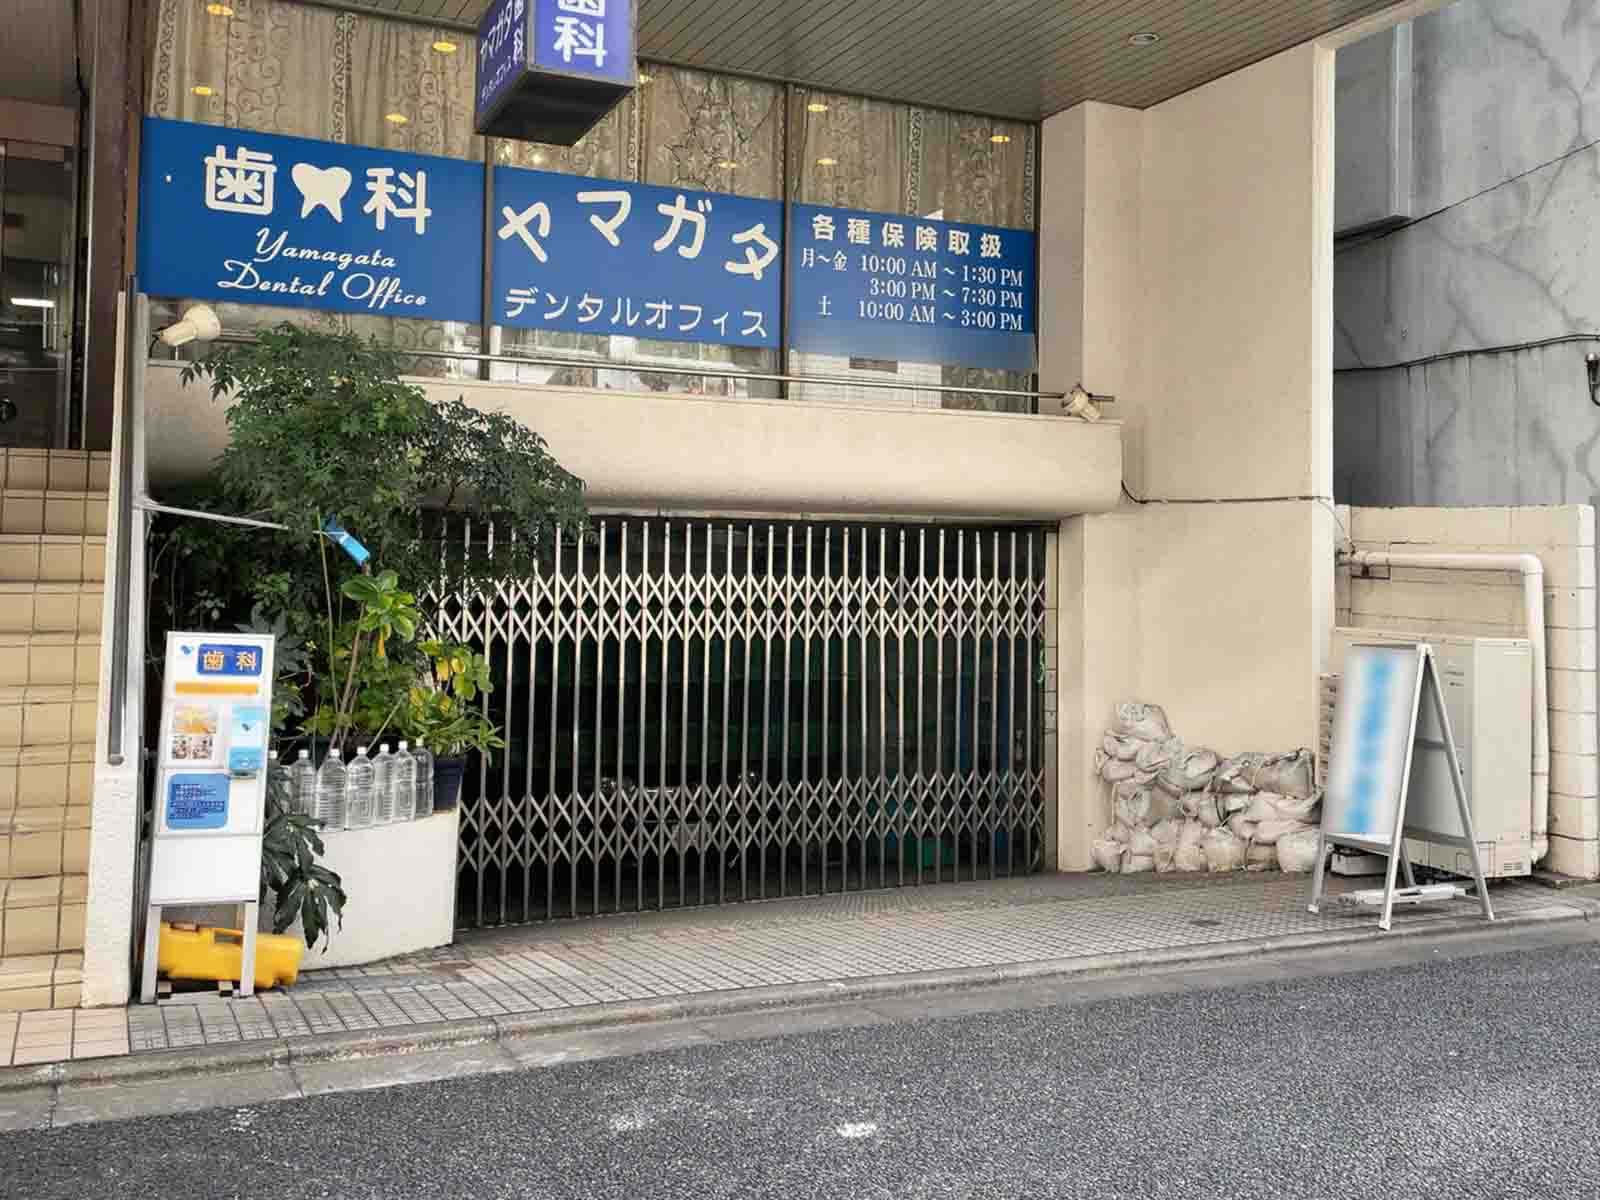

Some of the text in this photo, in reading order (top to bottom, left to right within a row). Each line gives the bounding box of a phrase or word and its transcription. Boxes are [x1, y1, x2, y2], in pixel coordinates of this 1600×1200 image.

[253, 228, 397, 271] Yamagata
[498, 190, 780, 281] ヤマガタ
[811, 213, 1003, 259] 各種保険取扱
[216, 260, 428, 309] Dental Office
[861, 255, 907, 276] 10:00
[911, 261, 938, 279] AM
[962, 265, 997, 284] 1:30
[1000, 269, 1024, 287] PM
[505, 287, 768, 338] デンタルオフィス
[858, 300, 905, 321] 10:00
[908, 305, 936, 324] AM
[961, 310, 997, 329] 3:00
[1000, 313, 1023, 331] PM
[869, 278, 907, 298] 3:00
[911, 282, 936, 301] PM
[961, 287, 997, 307] 7:30
[1000, 290, 1023, 309] PM
